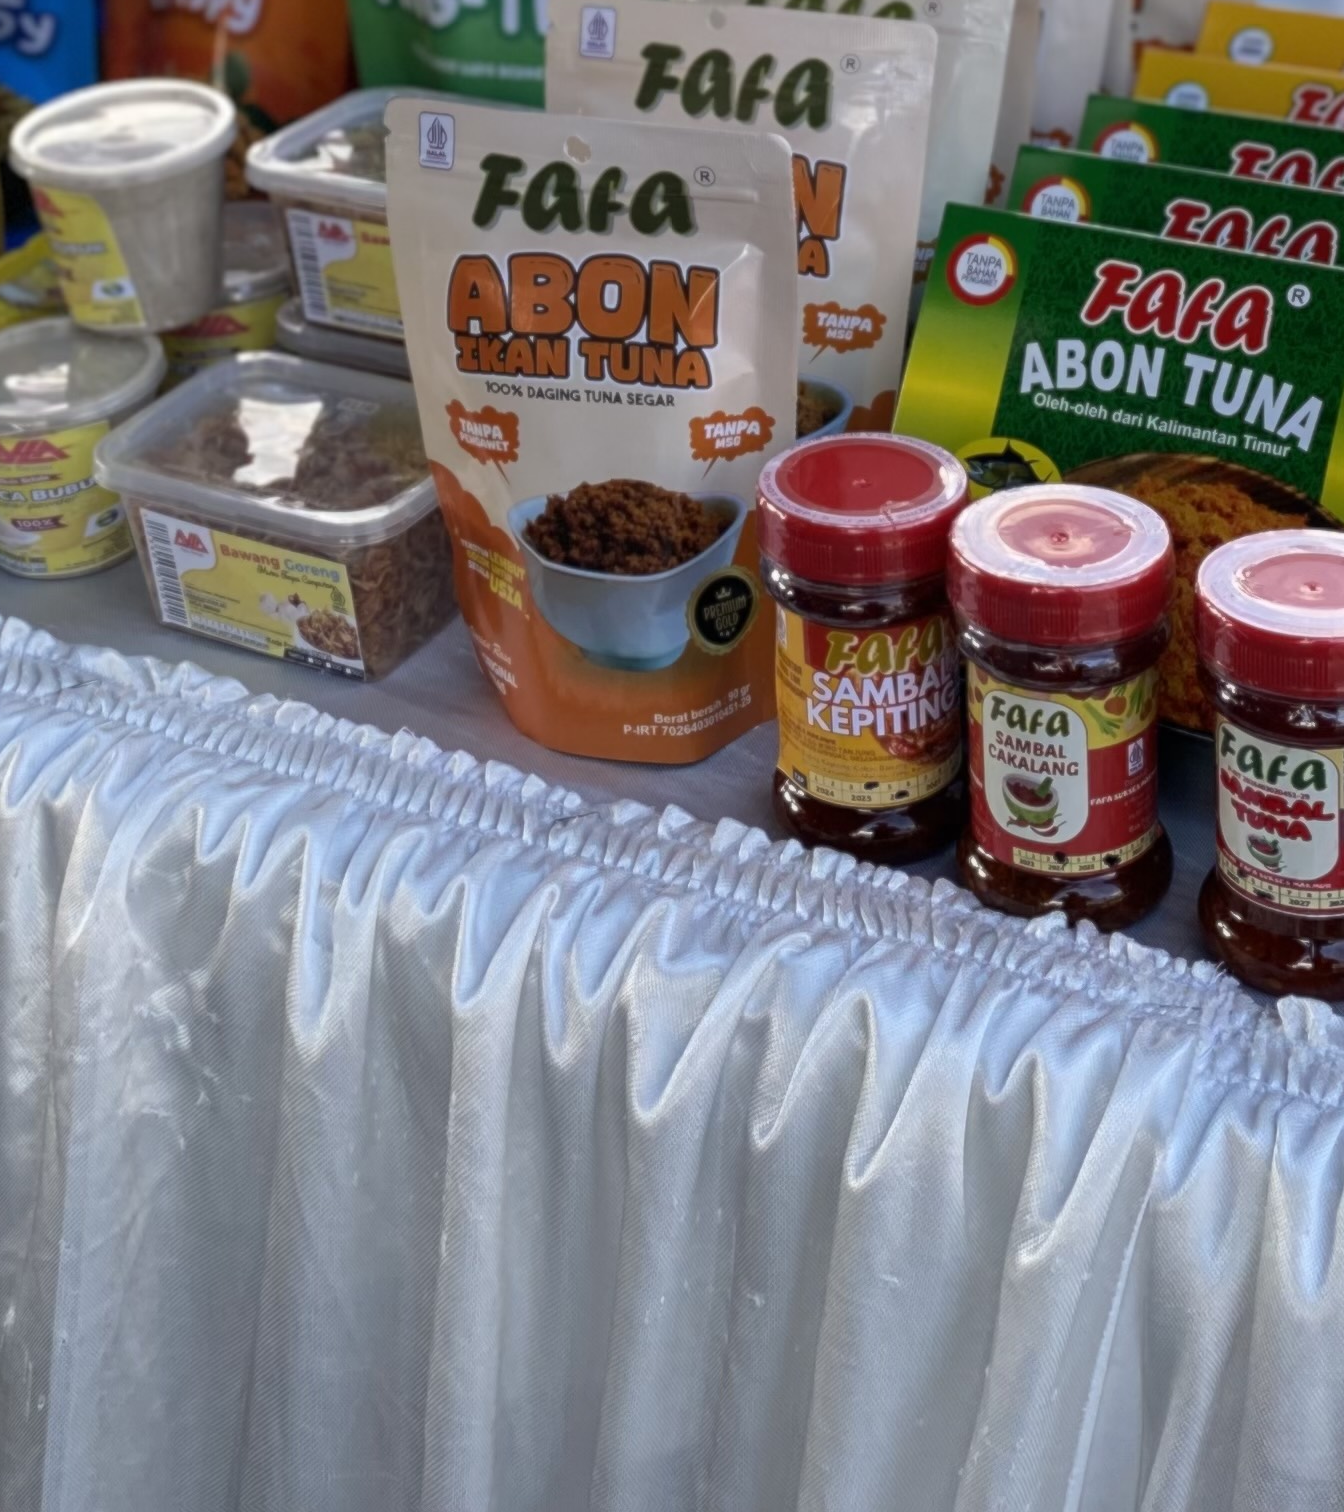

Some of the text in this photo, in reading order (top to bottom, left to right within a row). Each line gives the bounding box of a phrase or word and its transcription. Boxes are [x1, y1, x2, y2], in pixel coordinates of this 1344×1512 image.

[634, 42, 832, 130] Fafa
[1110, 138, 1145, 156] TANPA
[471, 152, 699, 236] Fafa
[1040, 193, 1076, 209] TANPA
[1040, 205, 1072, 219] BAHAN
[966, 252, 1003, 270] TANPA
[966, 266, 998, 279] BAHAN
[447, 252, 721, 350] ABON
[1080, 259, 1274, 355] Fafa
[817, 311, 873, 333] TANPA
[825, 327, 854, 341] MSG
[455, 334, 713, 389] IKAN TUNA
[484, 379, 675, 407] 100% DAGING TUNA SEGAR
[1019, 338, 1324, 452] ABON TUNA
[459, 416, 504, 441] TANPA
[703, 419, 761, 440] TANPA
[1033, 391, 1292, 458] Oleh-oleh dari Kalimantan Timur
[714, 434, 742, 450] MSG
[14, 518, 55, 529] 100%
[219, 543, 282, 570] Bawang
[283, 558, 341, 583] Goreng
[703, 595, 747, 622] PREMIUM
[715, 612, 739, 631] GOLD
[825, 614, 946, 678] Fafa
[812, 656, 954, 707] SAMBAL
[653, 712, 689, 725] Berat
[690, 699, 723, 717] bersih
[727, 688, 740, 701] 90
[806, 679, 958, 737] KEPITING
[990, 695, 1071, 738] Fafa
[622, 724, 658, 737] P-IRT
[995, 730, 1068, 759] SAMBAL
[987, 743, 1080, 777] CAKALANG
[1220, 725, 1328, 792] Fafa
[850, 793, 873, 803] 2025
[1219, 766, 1336, 822] SAMBAL
[1230, 796, 1313, 842] TUNA
